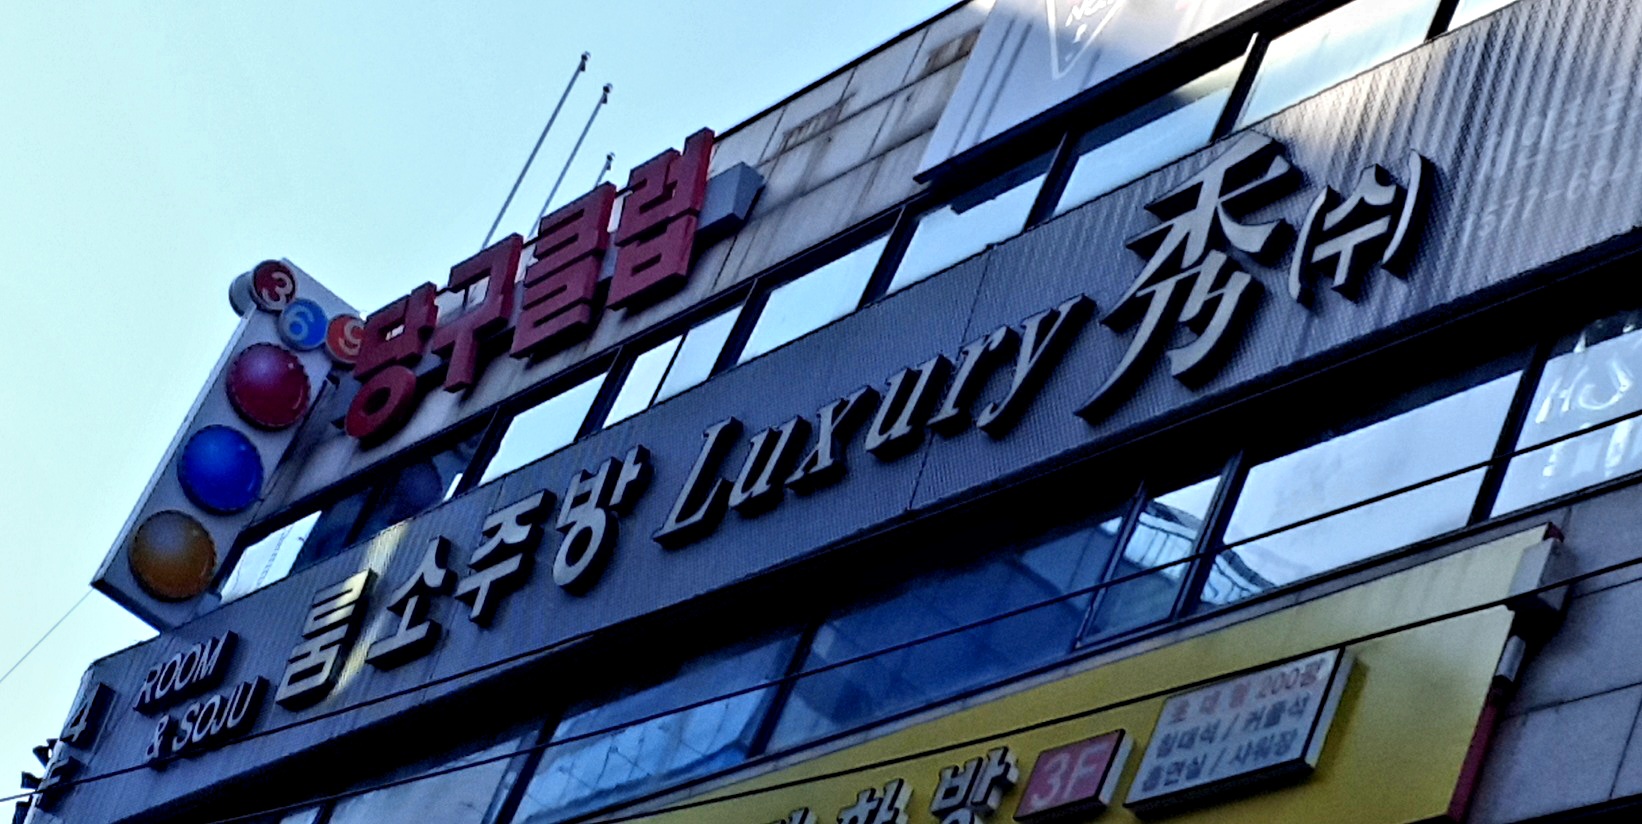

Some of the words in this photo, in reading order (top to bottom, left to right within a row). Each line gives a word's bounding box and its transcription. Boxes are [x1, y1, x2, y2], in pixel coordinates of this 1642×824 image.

[262, 271, 294, 311] 3
[285, 304, 314, 342] 6
[345, 127, 712, 438] 당구클럽
[276, 445, 646, 704] 룸소주방
[653, 294, 1090, 542] Luxury
[134, 630, 230, 711] ROOM
[146, 715, 170, 761] &
[172, 676, 260, 753] SOJU
[1030, 740, 1112, 809] 3F
